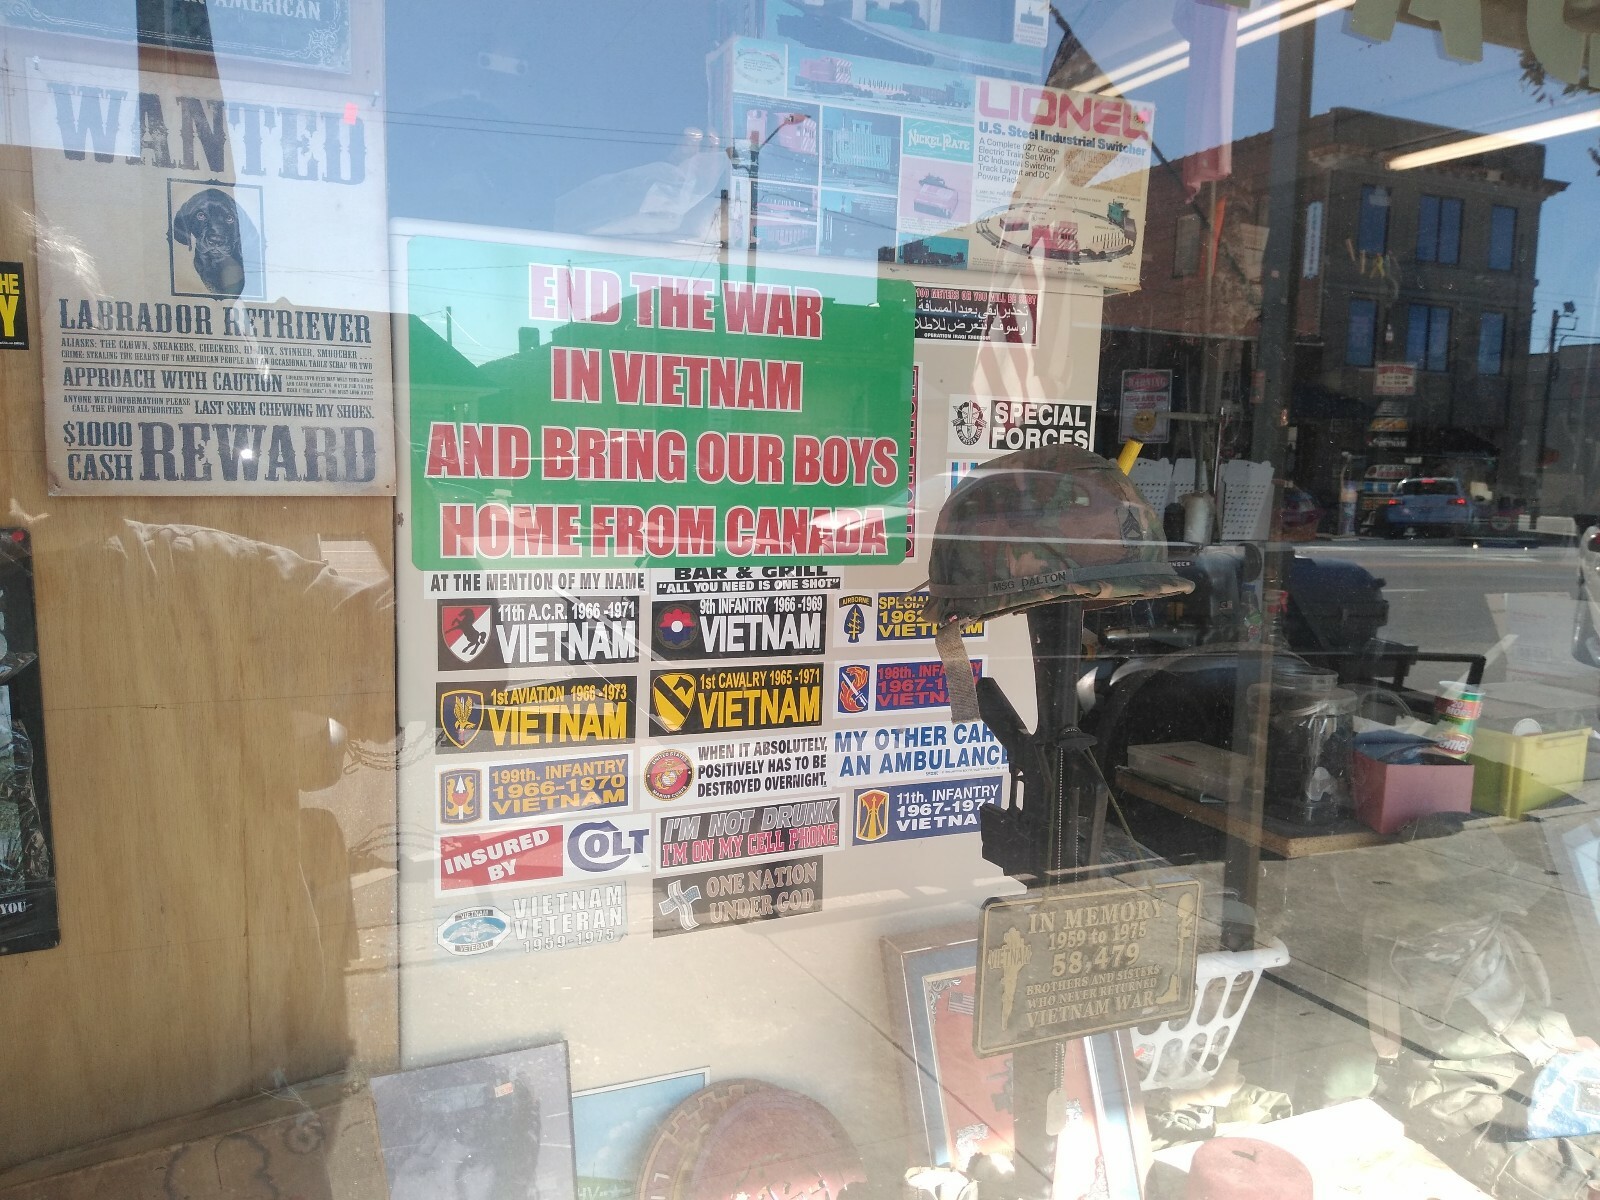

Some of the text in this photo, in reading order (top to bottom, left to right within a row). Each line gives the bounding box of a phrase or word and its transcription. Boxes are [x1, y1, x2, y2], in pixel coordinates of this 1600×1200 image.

[979, 80, 1148, 141] LIONEL
[46, 81, 366, 185] WANTED
[979, 121, 1147, 156] U.S. Steel Industrial Switcher
[1007, 149, 1024, 158] Train
[1025, 152, 1037, 160] Set
[1038, 153, 1055, 163] With
[1038, 144, 1060, 156] Gauge
[1025, 168, 1038, 178] and
[1039, 170, 1050, 179] DC
[528, 262, 823, 340] END THE WAR
[59, 298, 372, 344] LABRADOR RETRIEVER
[63, 367, 156, 388] APPROACH
[160, 370, 208, 390] WITH
[212, 372, 282, 392] CAUTION
[551, 346, 804, 413] IN VIETNAM
[195, 400, 375, 419] LAST SEEN CHEWING MY SHOES.
[994, 401, 1087, 427] SPECIAL
[63, 420, 133, 447] $1000
[991, 426, 1089, 451] FORCES
[138, 421, 376, 482] REWARD
[424, 420, 900, 488] AND BRING OUR BOYS
[67, 453, 134, 481] CASH
[439, 502, 889, 559] HOME FROM CANADA
[430, 572, 645, 592] AT THE MENTION OF MY NAME
[674, 566, 728, 580] BAR
[761, 565, 828, 579] GRILL
[693, 581, 719, 593] YOU
[722, 580, 753, 592] NEED
[759, 579, 771, 590] IS
[774, 579, 798, 590] ONE
[992, 570, 1067, 592] MSG DALTON
[498, 602, 601, 622] 11th A.C.R. 1966
[699, 596, 796, 615] 9th INFANTRY 1966
[496, 620, 636, 664] VIETNAM
[700, 612, 821, 653] VIETNAM
[700, 669, 793, 690] 1st CAVALRY 1965
[490, 684, 596, 706] 1st AVIATION 1966
[697, 686, 820, 729] VIETNAM
[488, 701, 628, 746] VIETNAM
[698, 736, 828, 761] WHEN IT ABSOLUTELY,
[834, 726, 947, 753] MY OTHER
[491, 758, 626, 785] 199th. INFANTRY
[697, 754, 827, 780] POSITIVELY HAS TO BE
[839, 754, 871, 777] AN
[492, 774, 626, 800] 1966-1970
[697, 772, 827, 798] DESTROYED OVERNIGHT.
[932, 784, 1000, 802] INFANTRY
[492, 789, 626, 816] VIETNAM
[664, 800, 838, 843] I'M NOT DRUNK
[896, 814, 978, 832] VIETNA
[444, 829, 550, 875] INSURED
[567, 820, 650, 872] COLT
[663, 822, 839, 867] I'M ON MY CELL PHONE
[487, 858, 518, 882] BY
[706, 861, 818, 898] ONE NATION
[513, 884, 623, 919] VIETNAM
[709, 887, 815, 924] UNDER GOD
[515, 907, 622, 941] VETERAN
[1028, 899, 1165, 935] IN MEMORY
[522, 929, 615, 954] 1959-1975
[1048, 921, 1147, 951] 1959 to 1975
[1051, 942, 1141, 977] 58,479
[1026, 964, 1161, 996] BROTHERS AND SISTERS
[1027, 977, 1158, 1010] WHO NEVER RETURNED
[1026, 991, 1157, 1028] VIETNAM WAR
